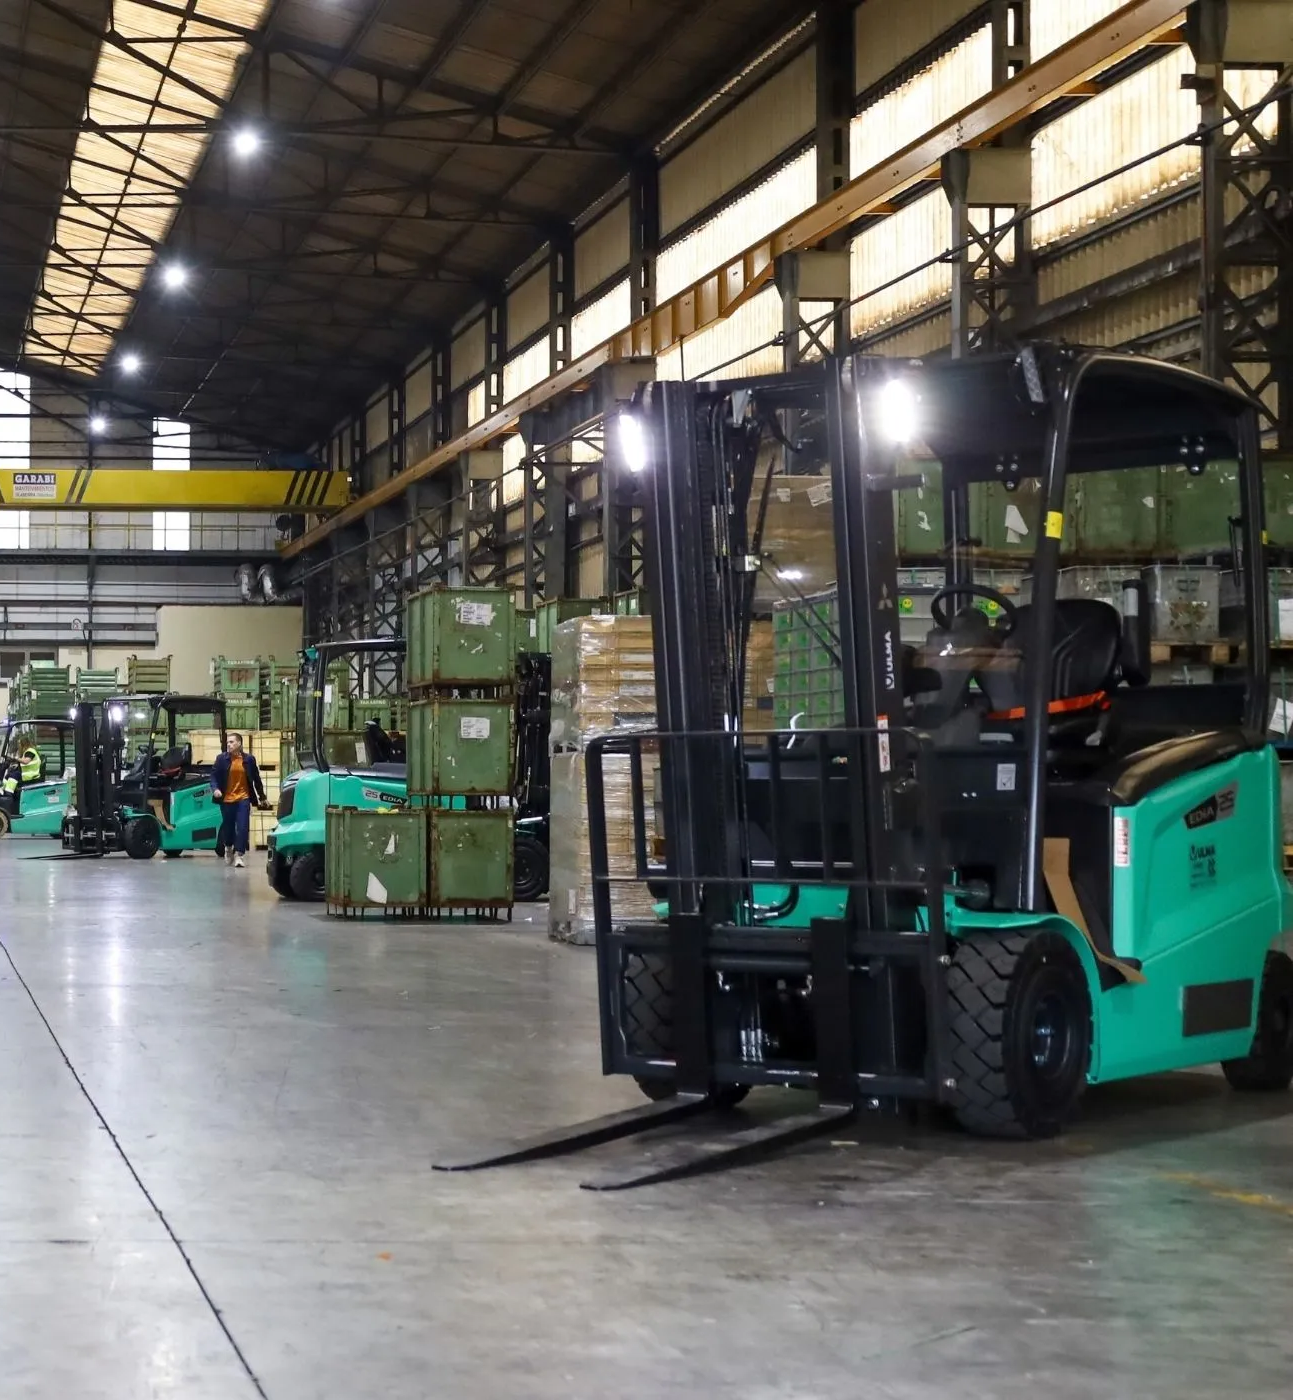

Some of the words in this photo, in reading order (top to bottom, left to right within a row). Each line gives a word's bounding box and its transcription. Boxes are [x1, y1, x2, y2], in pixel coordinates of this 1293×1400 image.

[15, 475, 54, 483] GARABI
[885, 631, 893, 672] ULMA
[365, 790, 378, 798] 25
